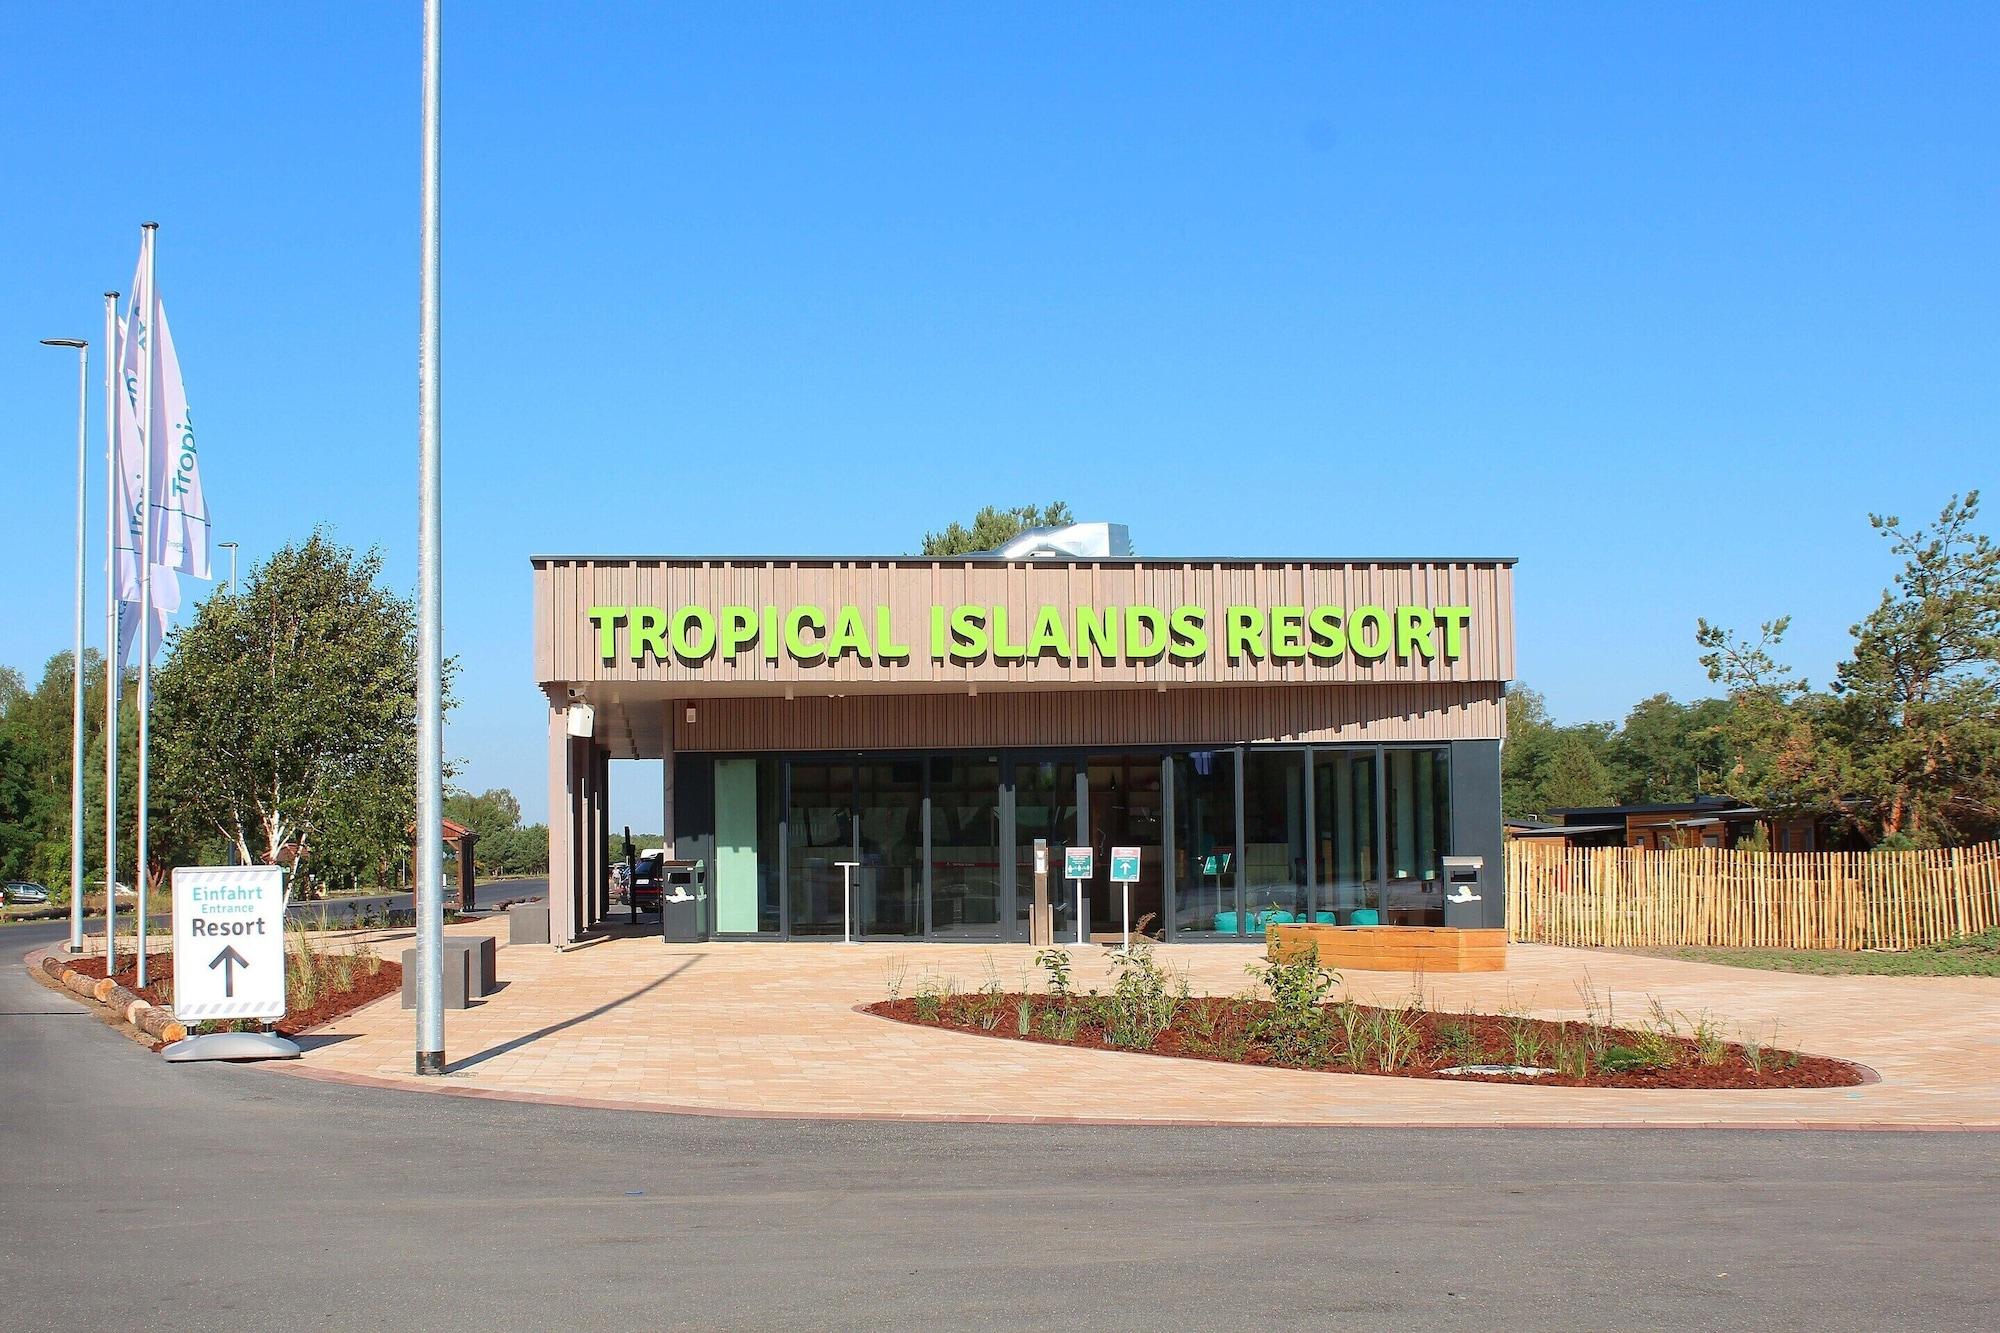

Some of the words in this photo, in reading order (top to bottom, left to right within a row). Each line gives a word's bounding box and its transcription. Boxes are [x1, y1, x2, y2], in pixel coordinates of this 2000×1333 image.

[587, 605, 911, 659] TROPICAL
[931, 605, 1208, 659] ISLANDS
[1227, 605, 1472, 659] RESORT
[193, 885, 263, 901] Einfahrt
[201, 903, 254, 914] Entrance
[192, 917, 265, 937] Resort
